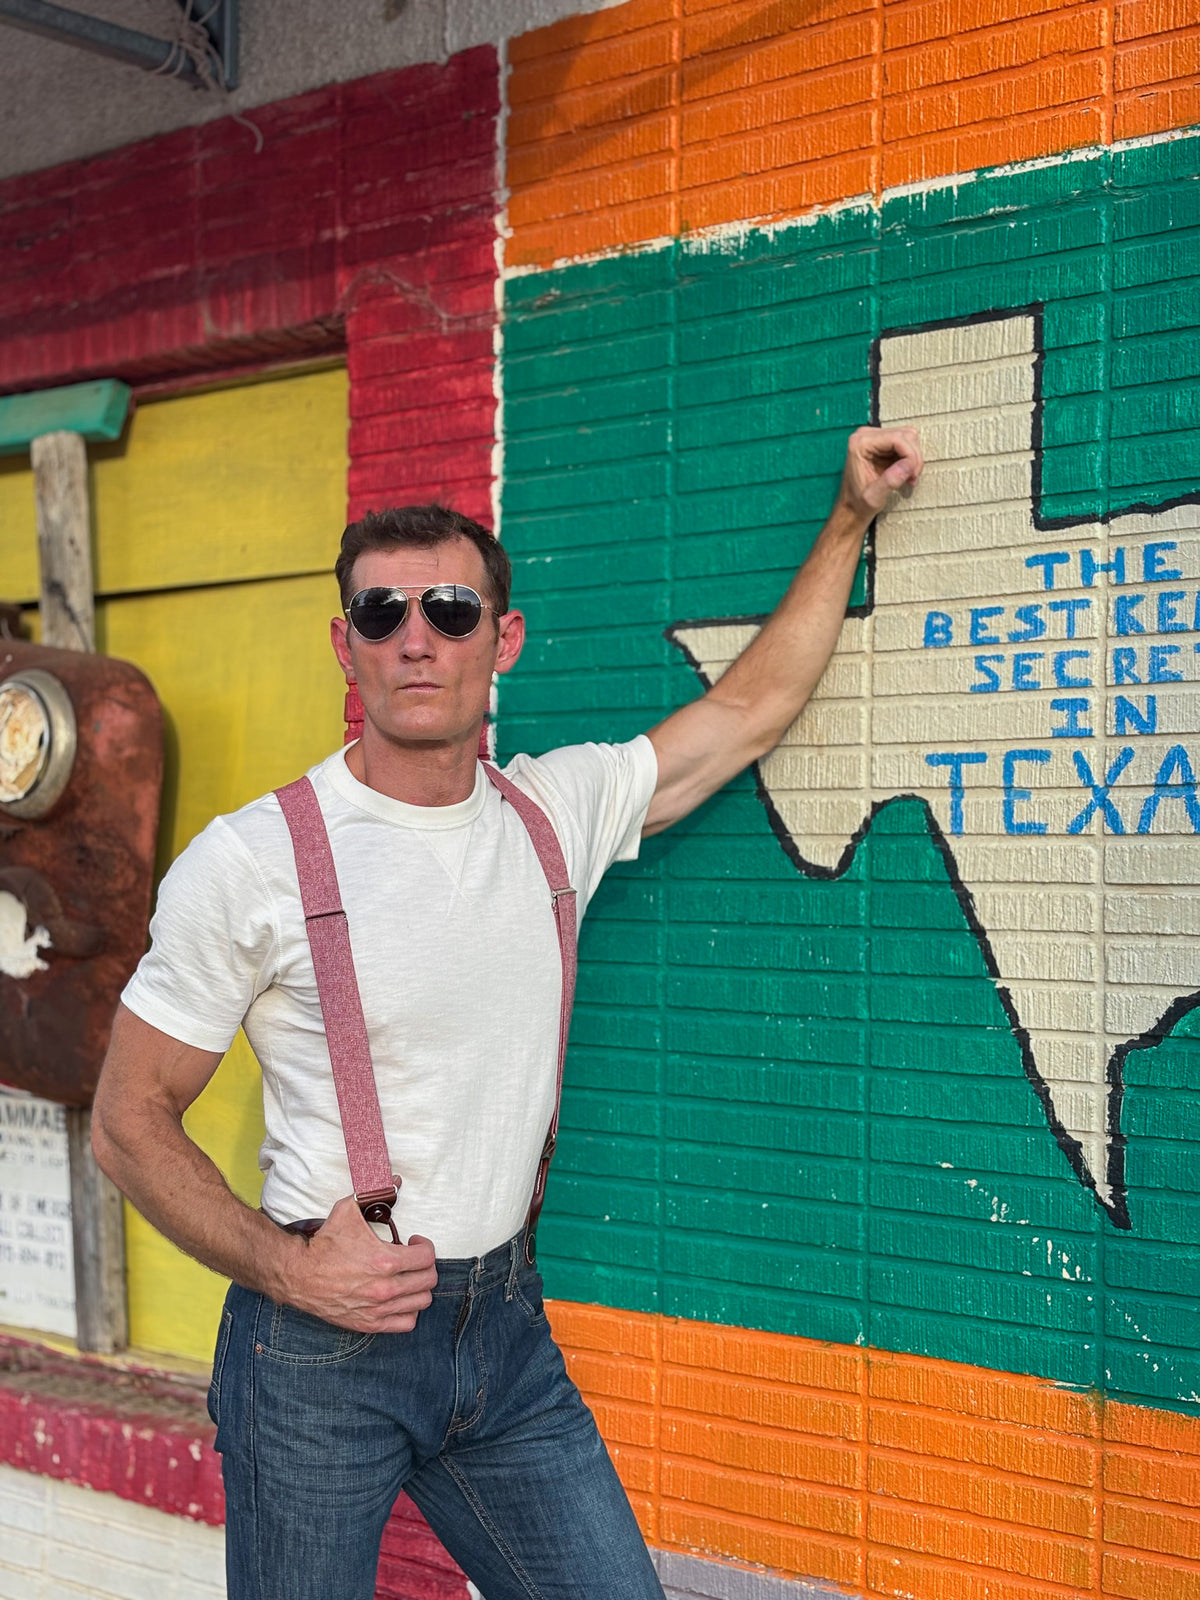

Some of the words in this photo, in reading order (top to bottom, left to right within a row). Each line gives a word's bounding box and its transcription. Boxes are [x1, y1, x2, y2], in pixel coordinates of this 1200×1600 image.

[1025, 541, 1183, 589] THE
[923, 598, 1091, 648] BEST
[1114, 590, 1200, 636] KE
[970, 642, 1200, 692] SECRE
[1050, 695, 1158, 738] IN
